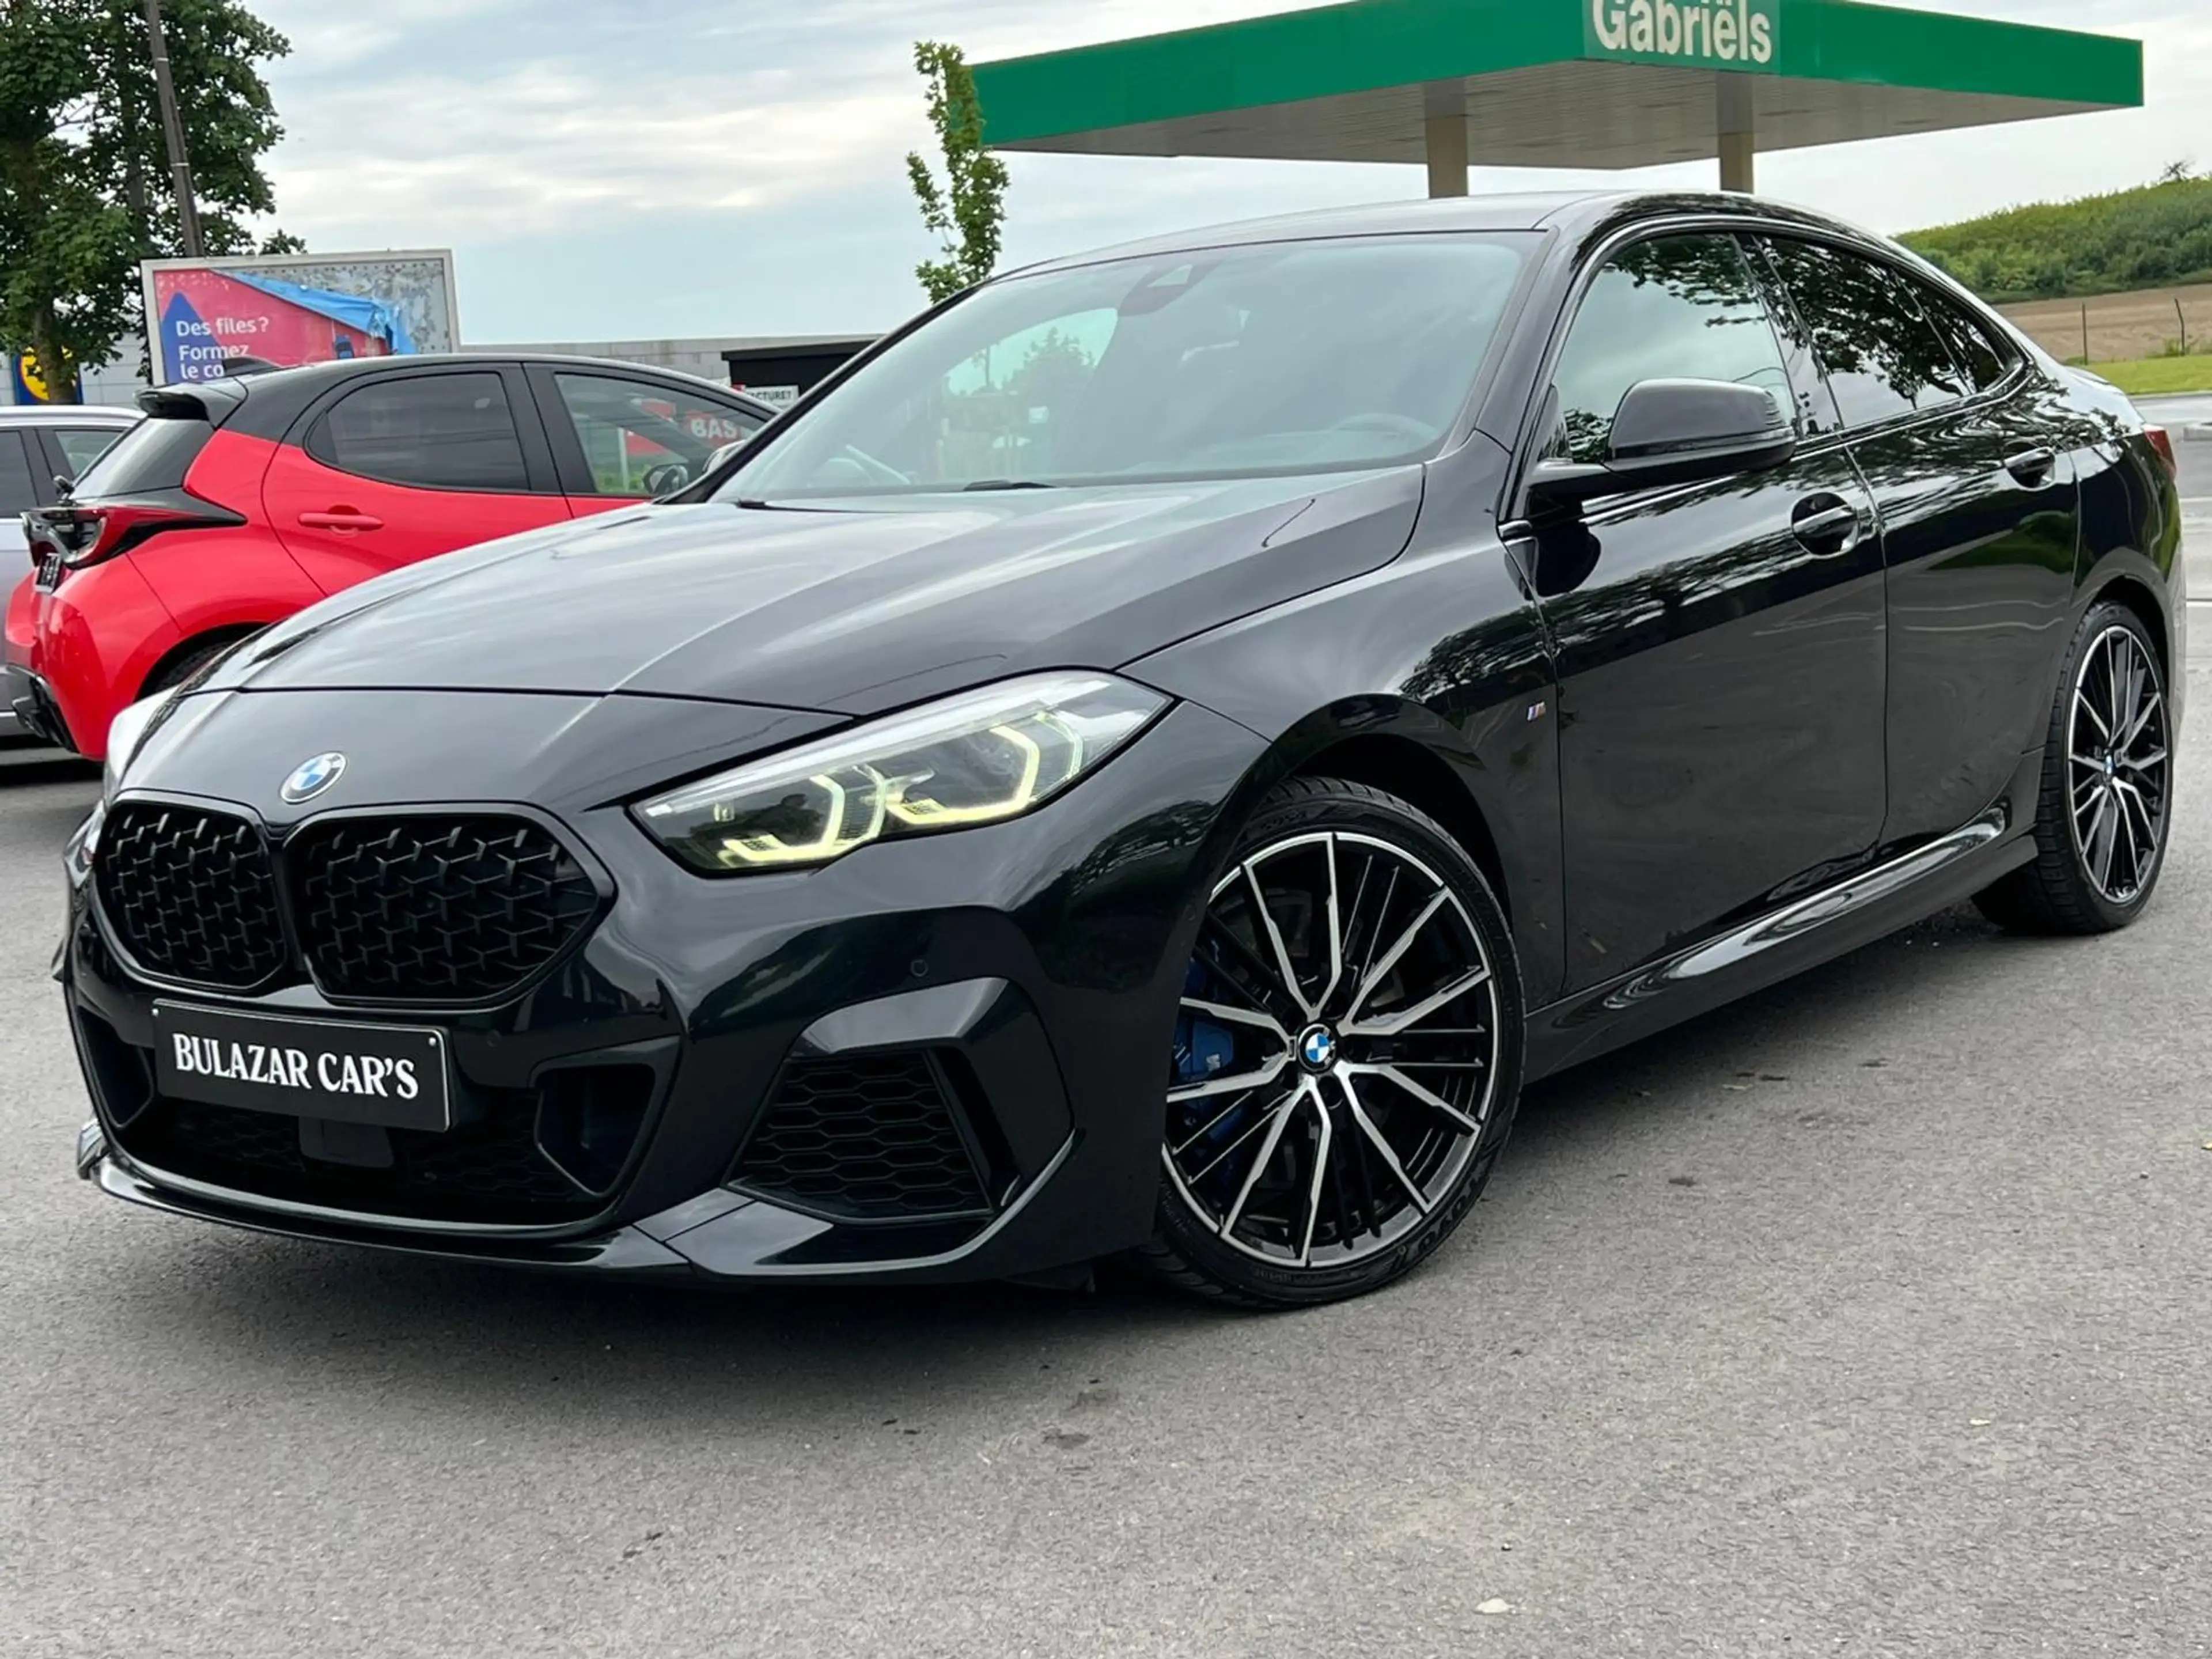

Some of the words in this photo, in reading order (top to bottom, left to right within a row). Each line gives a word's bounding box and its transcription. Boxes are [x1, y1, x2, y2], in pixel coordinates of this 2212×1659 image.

[1593, 0, 1771, 63] Gabriëls
[176, 321, 211, 336] Des
[179, 345, 249, 361] Formez
[180, 363, 198, 379] le
[691, 419, 737, 438] BAS
[173, 1033, 312, 1089] BULAZAR
[318, 1052, 419, 1099] CAR'S
